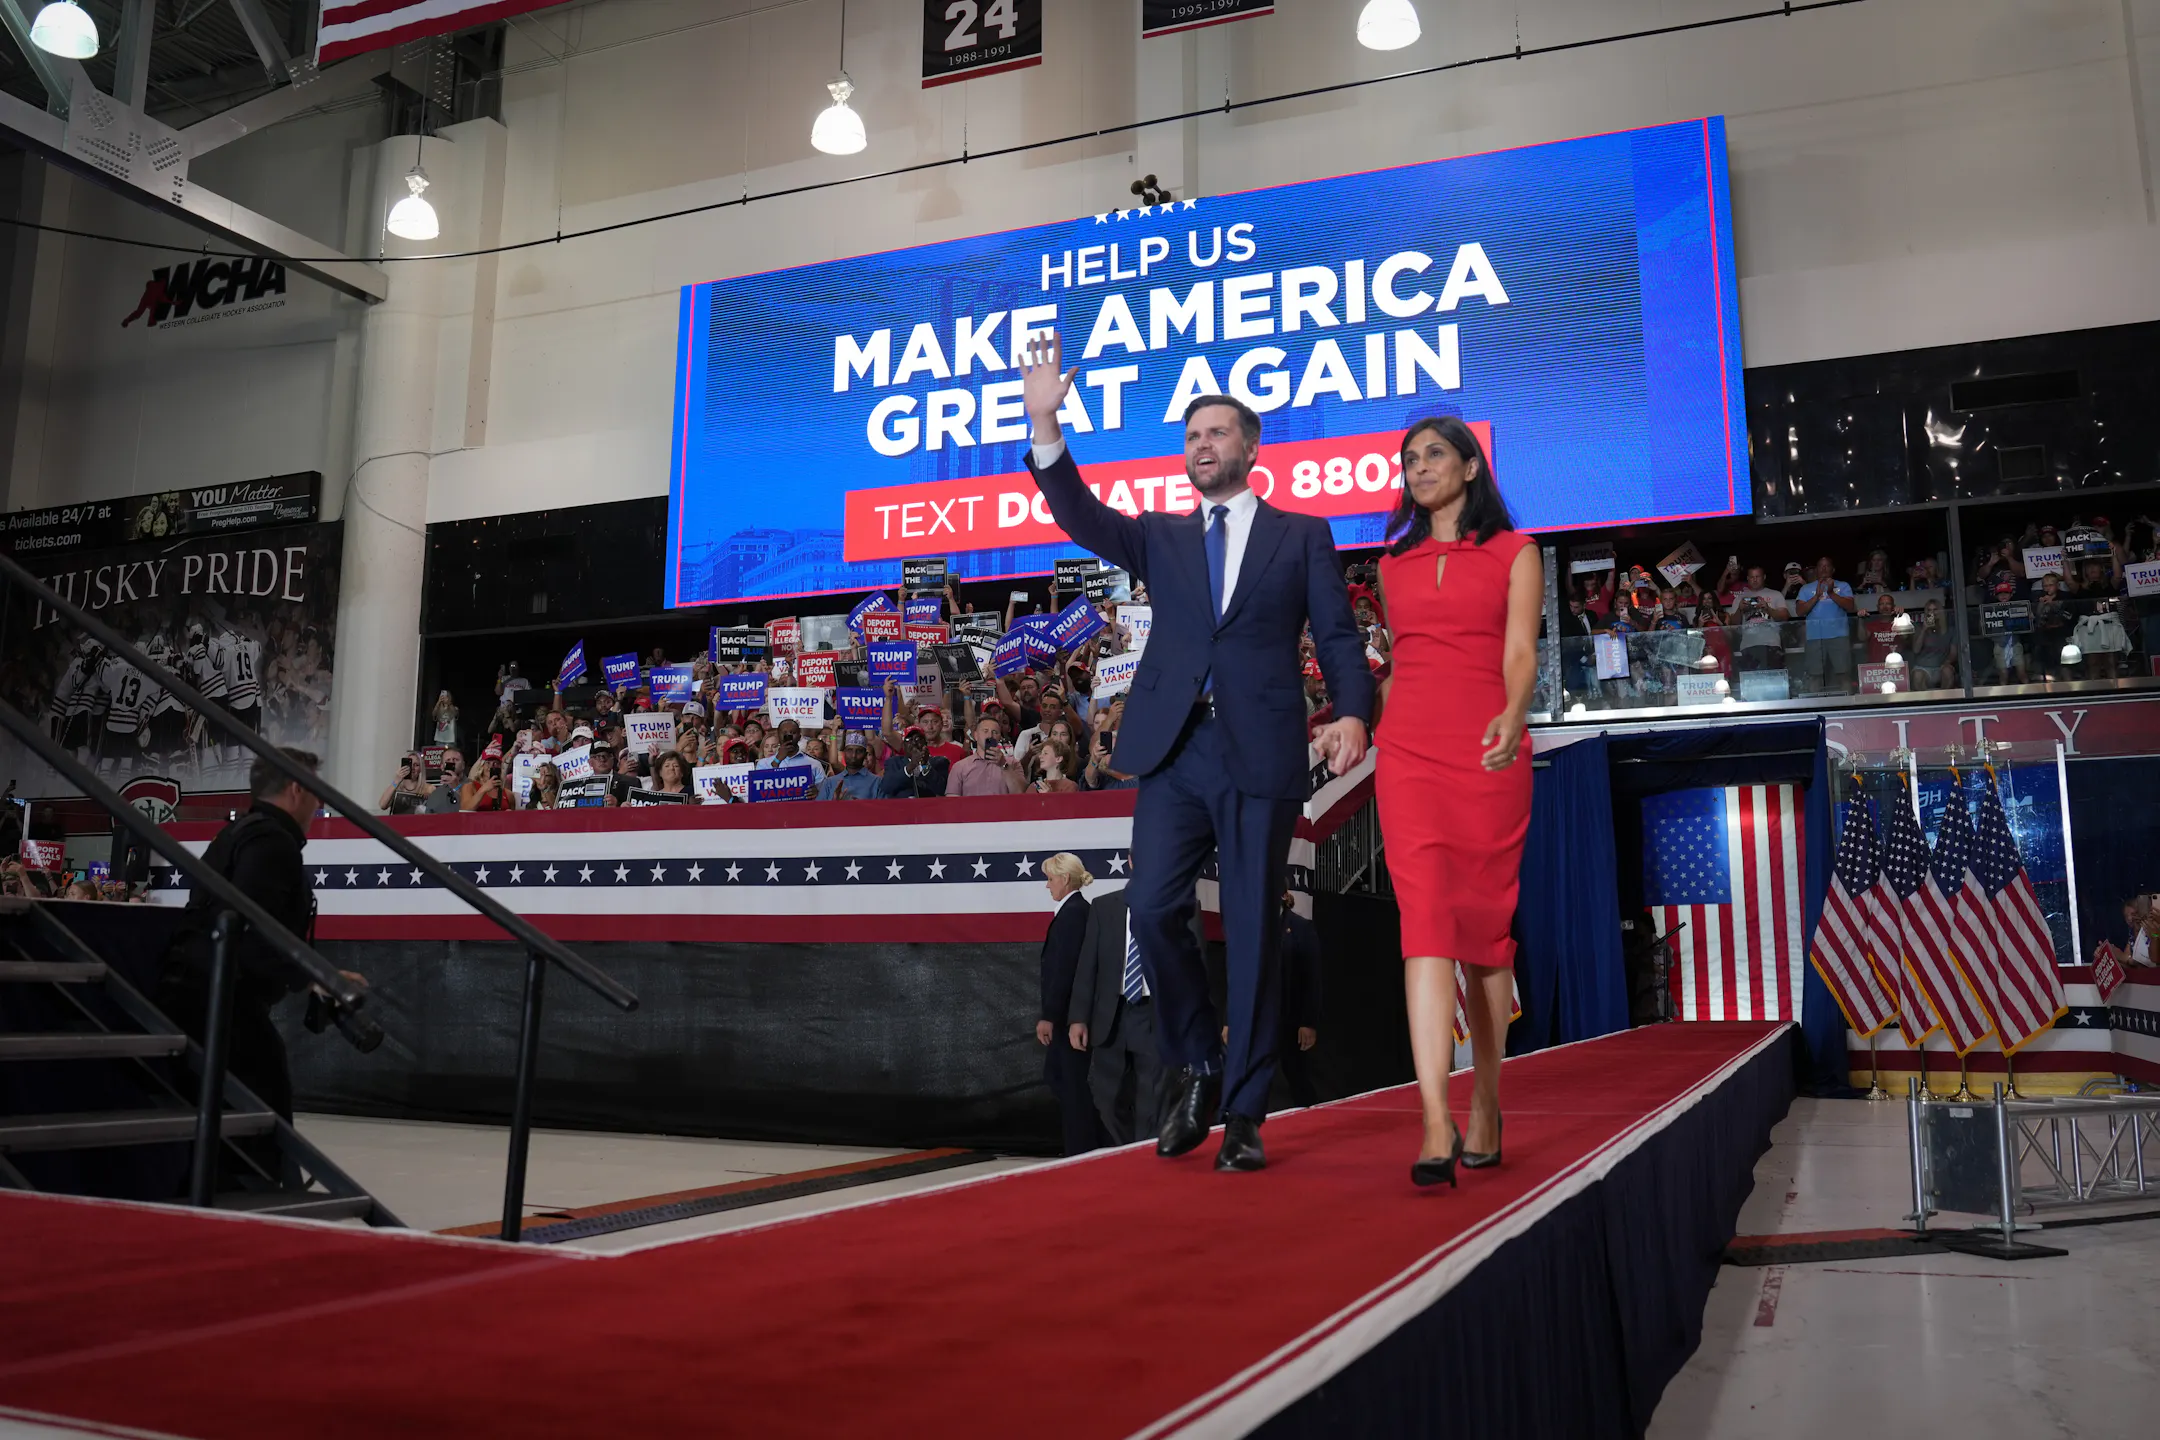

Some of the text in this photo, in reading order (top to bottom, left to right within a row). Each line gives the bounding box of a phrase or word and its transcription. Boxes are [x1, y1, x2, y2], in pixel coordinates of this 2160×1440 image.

[1171, 0, 1242, 19] 1995-1997
[944, 0, 1019, 51] 24
[949, 44, 1013, 66] 1988-1991
[1041, 222, 1257, 292] HELP US
[152, 256, 287, 322] WCHA
[159, 300, 286, 330] WESTERN COLLEGIATE HOCKEY ASSOCIATION
[833, 242, 1511, 394] MAKE AMERICA
[1164, 322, 1461, 426] AGAIN
[191, 487, 227, 508] YOU
[874, 495, 984, 540] TEXT
[998, 474, 1195, 529] DOATE
[8, 509, 59, 531] Available
[62, 506, 96, 525] 24/7
[98, 505, 111, 520] at
[211, 515, 257, 528] PregHelp.com
[14, 533, 82, 551] tickets.com
[2065, 532, 2090, 544] BACK
[2066, 544, 2084, 552] THE
[1663, 548, 1694, 573] TRUMP
[2028, 553, 2062, 563] TRUM
[180, 546, 308, 603] PRIDE
[904, 566, 926, 574] BACK
[1058, 566, 1080, 574] BACK
[905, 576, 920, 584] THE
[1058, 576, 1074, 584] THE
[1086, 578, 1109, 588] BACK
[1087, 589, 1103, 598] THE
[906, 605, 937, 615] TRUMP
[1985, 609, 2009, 619] BACK
[866, 619, 896, 627] DEPORT
[1050, 604, 1088, 639] TRUMP
[1986, 620, 2003, 628] THE
[776, 629, 801, 637] DEPOR
[865, 626, 899, 635] ILLEGALS
[1059, 615, 1090, 642] VANCE
[721, 636, 747, 645] BACK
[908, 631, 941, 640] DEPORT
[962, 634, 983, 645] BACK
[775, 637, 801, 645] ILLEGA
[1025, 634, 1056, 655] RUMP
[721, 647, 739, 655] THE
[995, 637, 1022, 656] TRUMP
[561, 648, 582, 672] TRUMP
[801, 657, 833, 666] DEPORT
[870, 651, 913, 662] TRUMP
[237, 652, 253, 681] 19
[605, 661, 636, 674] TRUMP
[875, 661, 907, 671] VANCE
[1865, 668, 1901, 677] DEPORT
[651, 675, 688, 684] TRUMP
[806, 674, 826, 683] NOW
[1863, 674, 1905, 684] ILLEGALS
[116, 675, 141, 707] 13
[722, 680, 764, 692] TRUMP
[904, 685, 933, 693] VANCE
[1682, 682, 1716, 690] TRUM
[726, 690, 759, 699] VANCE
[772, 698, 819, 707] TRUMP
[841, 696, 887, 707] TRUM
[777, 707, 814, 715] VANCE
[848, 707, 882, 715] VANC
[630, 722, 672, 733] TRUMP
[637, 731, 669, 740] VANCE
[557, 755, 589, 771] TRUM
[753, 775, 808, 790] TRUMP
[560, 786, 585, 797] BACK
[706, 786, 746, 796] VCE
[760, 788, 803, 798] VANCE
[558, 798, 603, 808] THE BLUE
